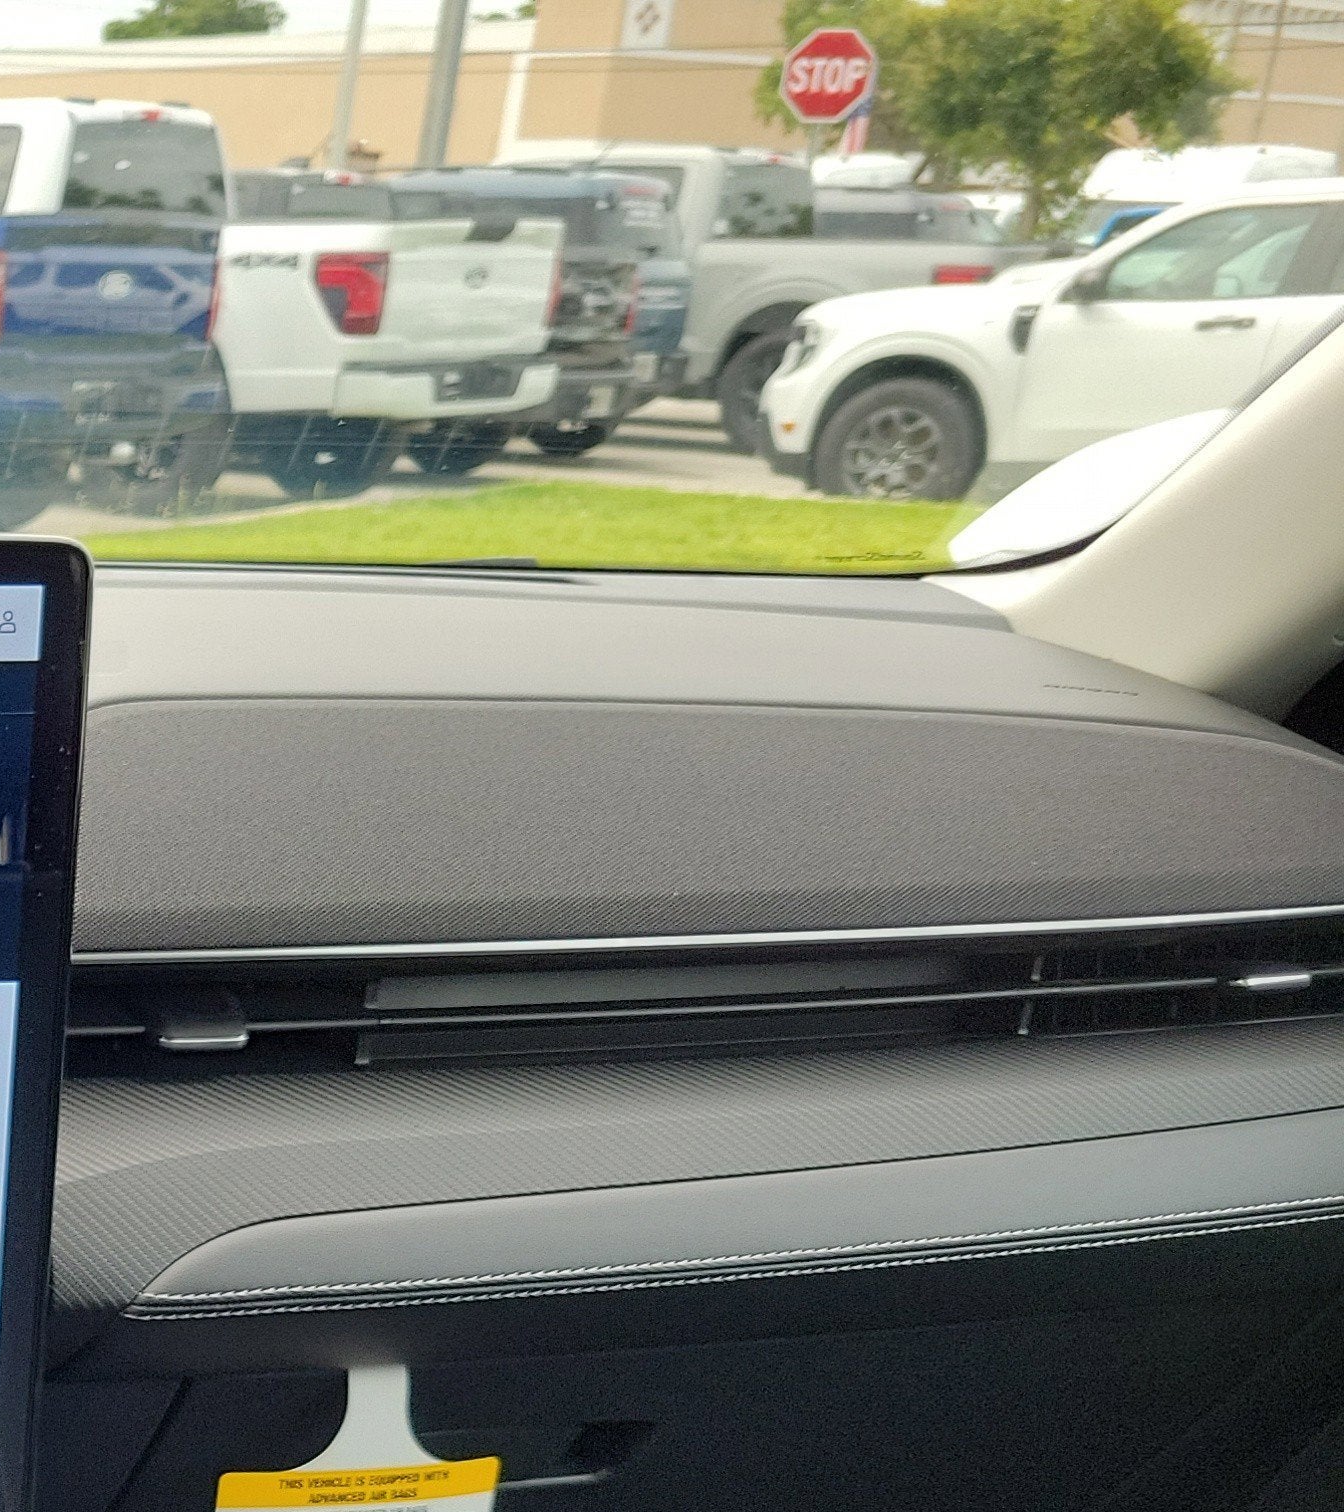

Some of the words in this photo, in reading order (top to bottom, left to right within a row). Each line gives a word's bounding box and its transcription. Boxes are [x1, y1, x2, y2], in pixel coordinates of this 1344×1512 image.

[787, 57, 868, 94] STOP
[278, 1478, 304, 1490] THIS
[307, 1476, 352, 1489] VEHICLE
[355, 1474, 365, 1486] IS
[368, 1472, 420, 1486] EQUIPPED
[423, 1470, 450, 1481] WITH
[308, 1490, 366, 1503] ADVANCED
[369, 1489, 388, 1500] AIR
[389, 1487, 418, 1499] BAGS
